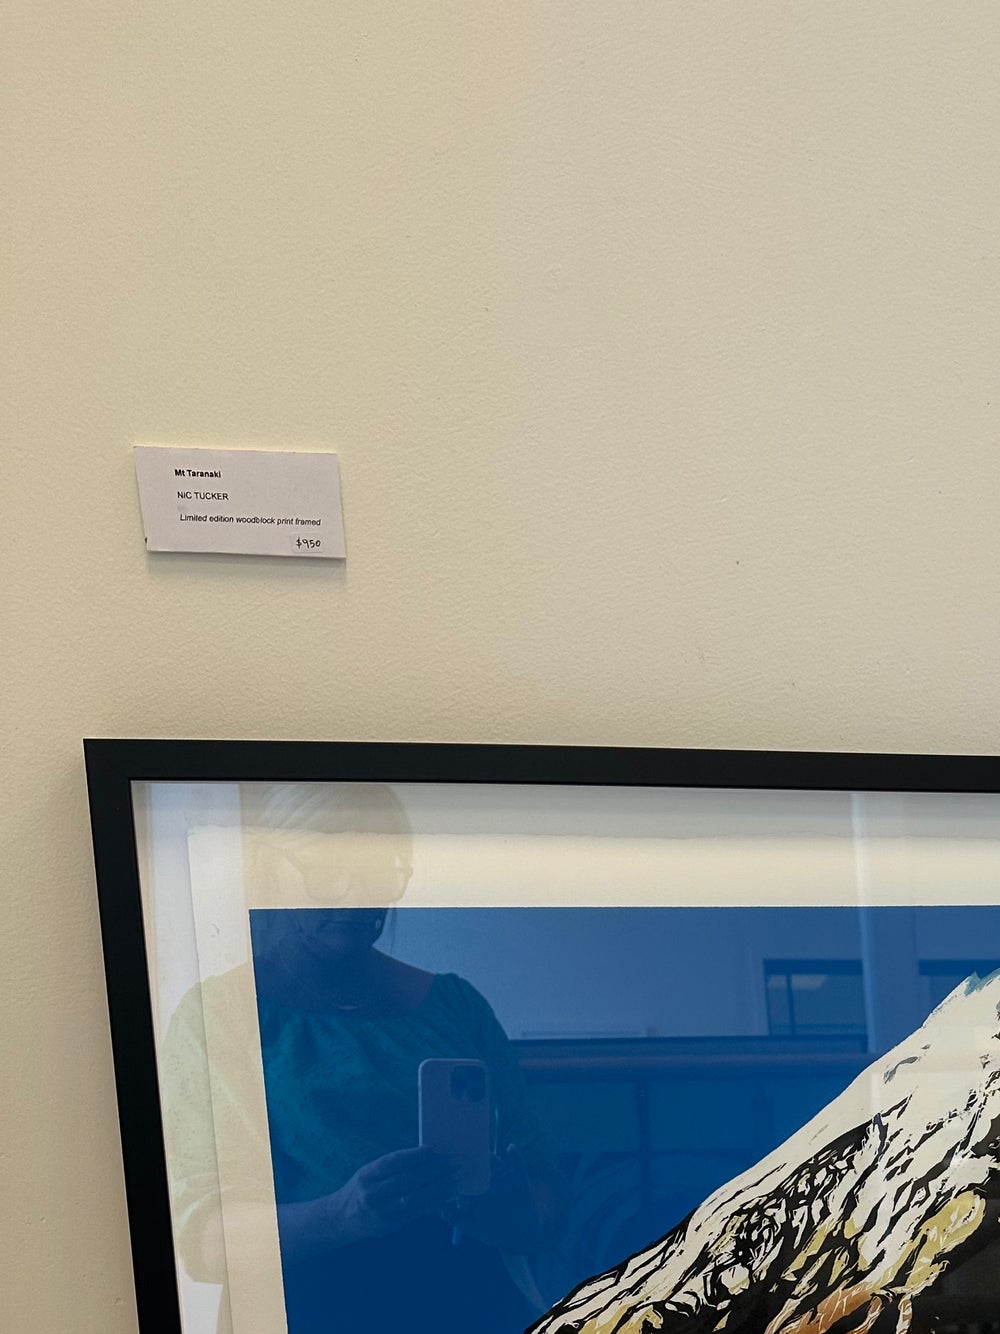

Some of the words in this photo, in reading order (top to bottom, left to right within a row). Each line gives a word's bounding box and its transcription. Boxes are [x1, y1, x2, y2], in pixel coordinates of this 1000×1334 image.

[174, 469, 185, 477] Mt
[186, 469, 221, 478] Taranaki
[177, 491, 192, 499] NIC
[193, 491, 229, 501] TUCKER
[180, 513, 207, 522] Limited
[209, 515, 234, 523] edition
[236, 516, 275, 524] woodblock
[277, 517, 293, 526] print
[295, 517, 322, 526] framed
[296, 536, 321, 549] $950
